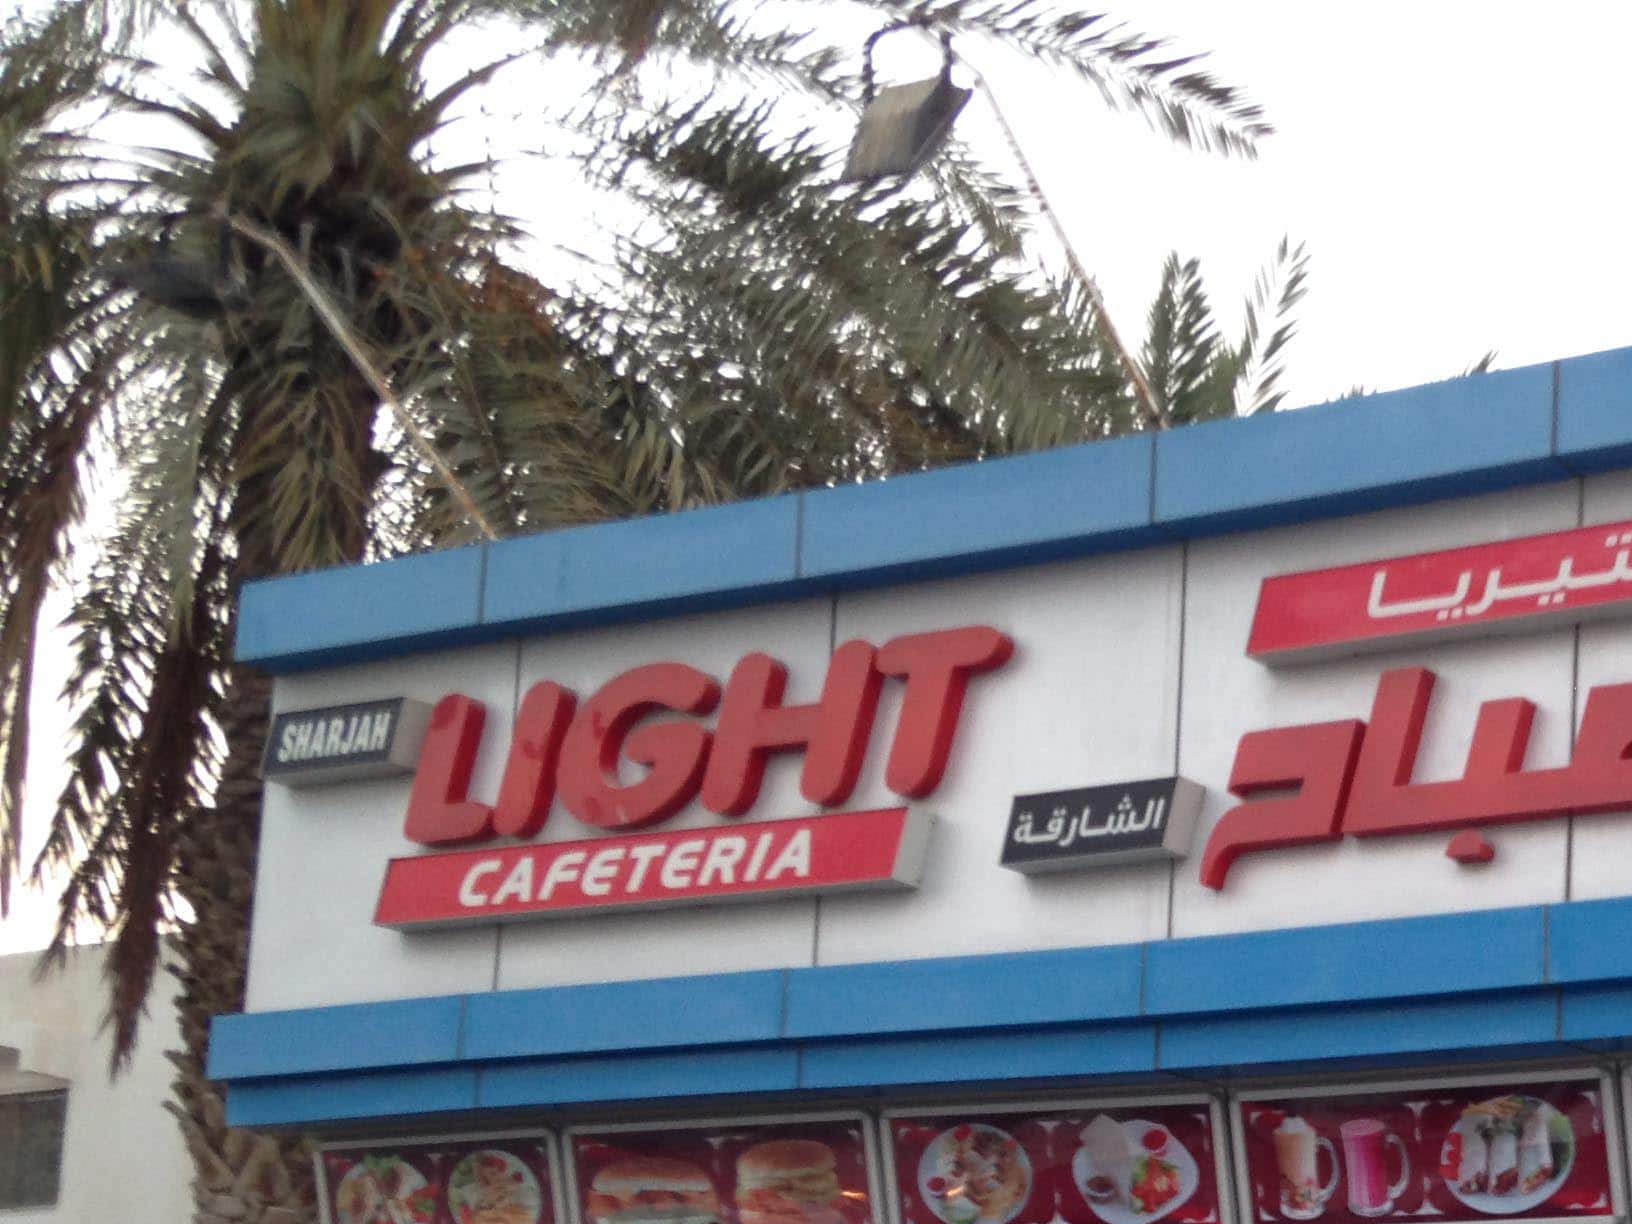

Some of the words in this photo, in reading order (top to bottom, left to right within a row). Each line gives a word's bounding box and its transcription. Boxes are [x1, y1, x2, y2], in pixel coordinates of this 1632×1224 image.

[278, 711, 391, 762] SHARJAH
[404, 625, 1015, 846] LIGHT
[1013, 793, 1165, 847] الشارقة
[458, 829, 812, 907] CAFETERIA
